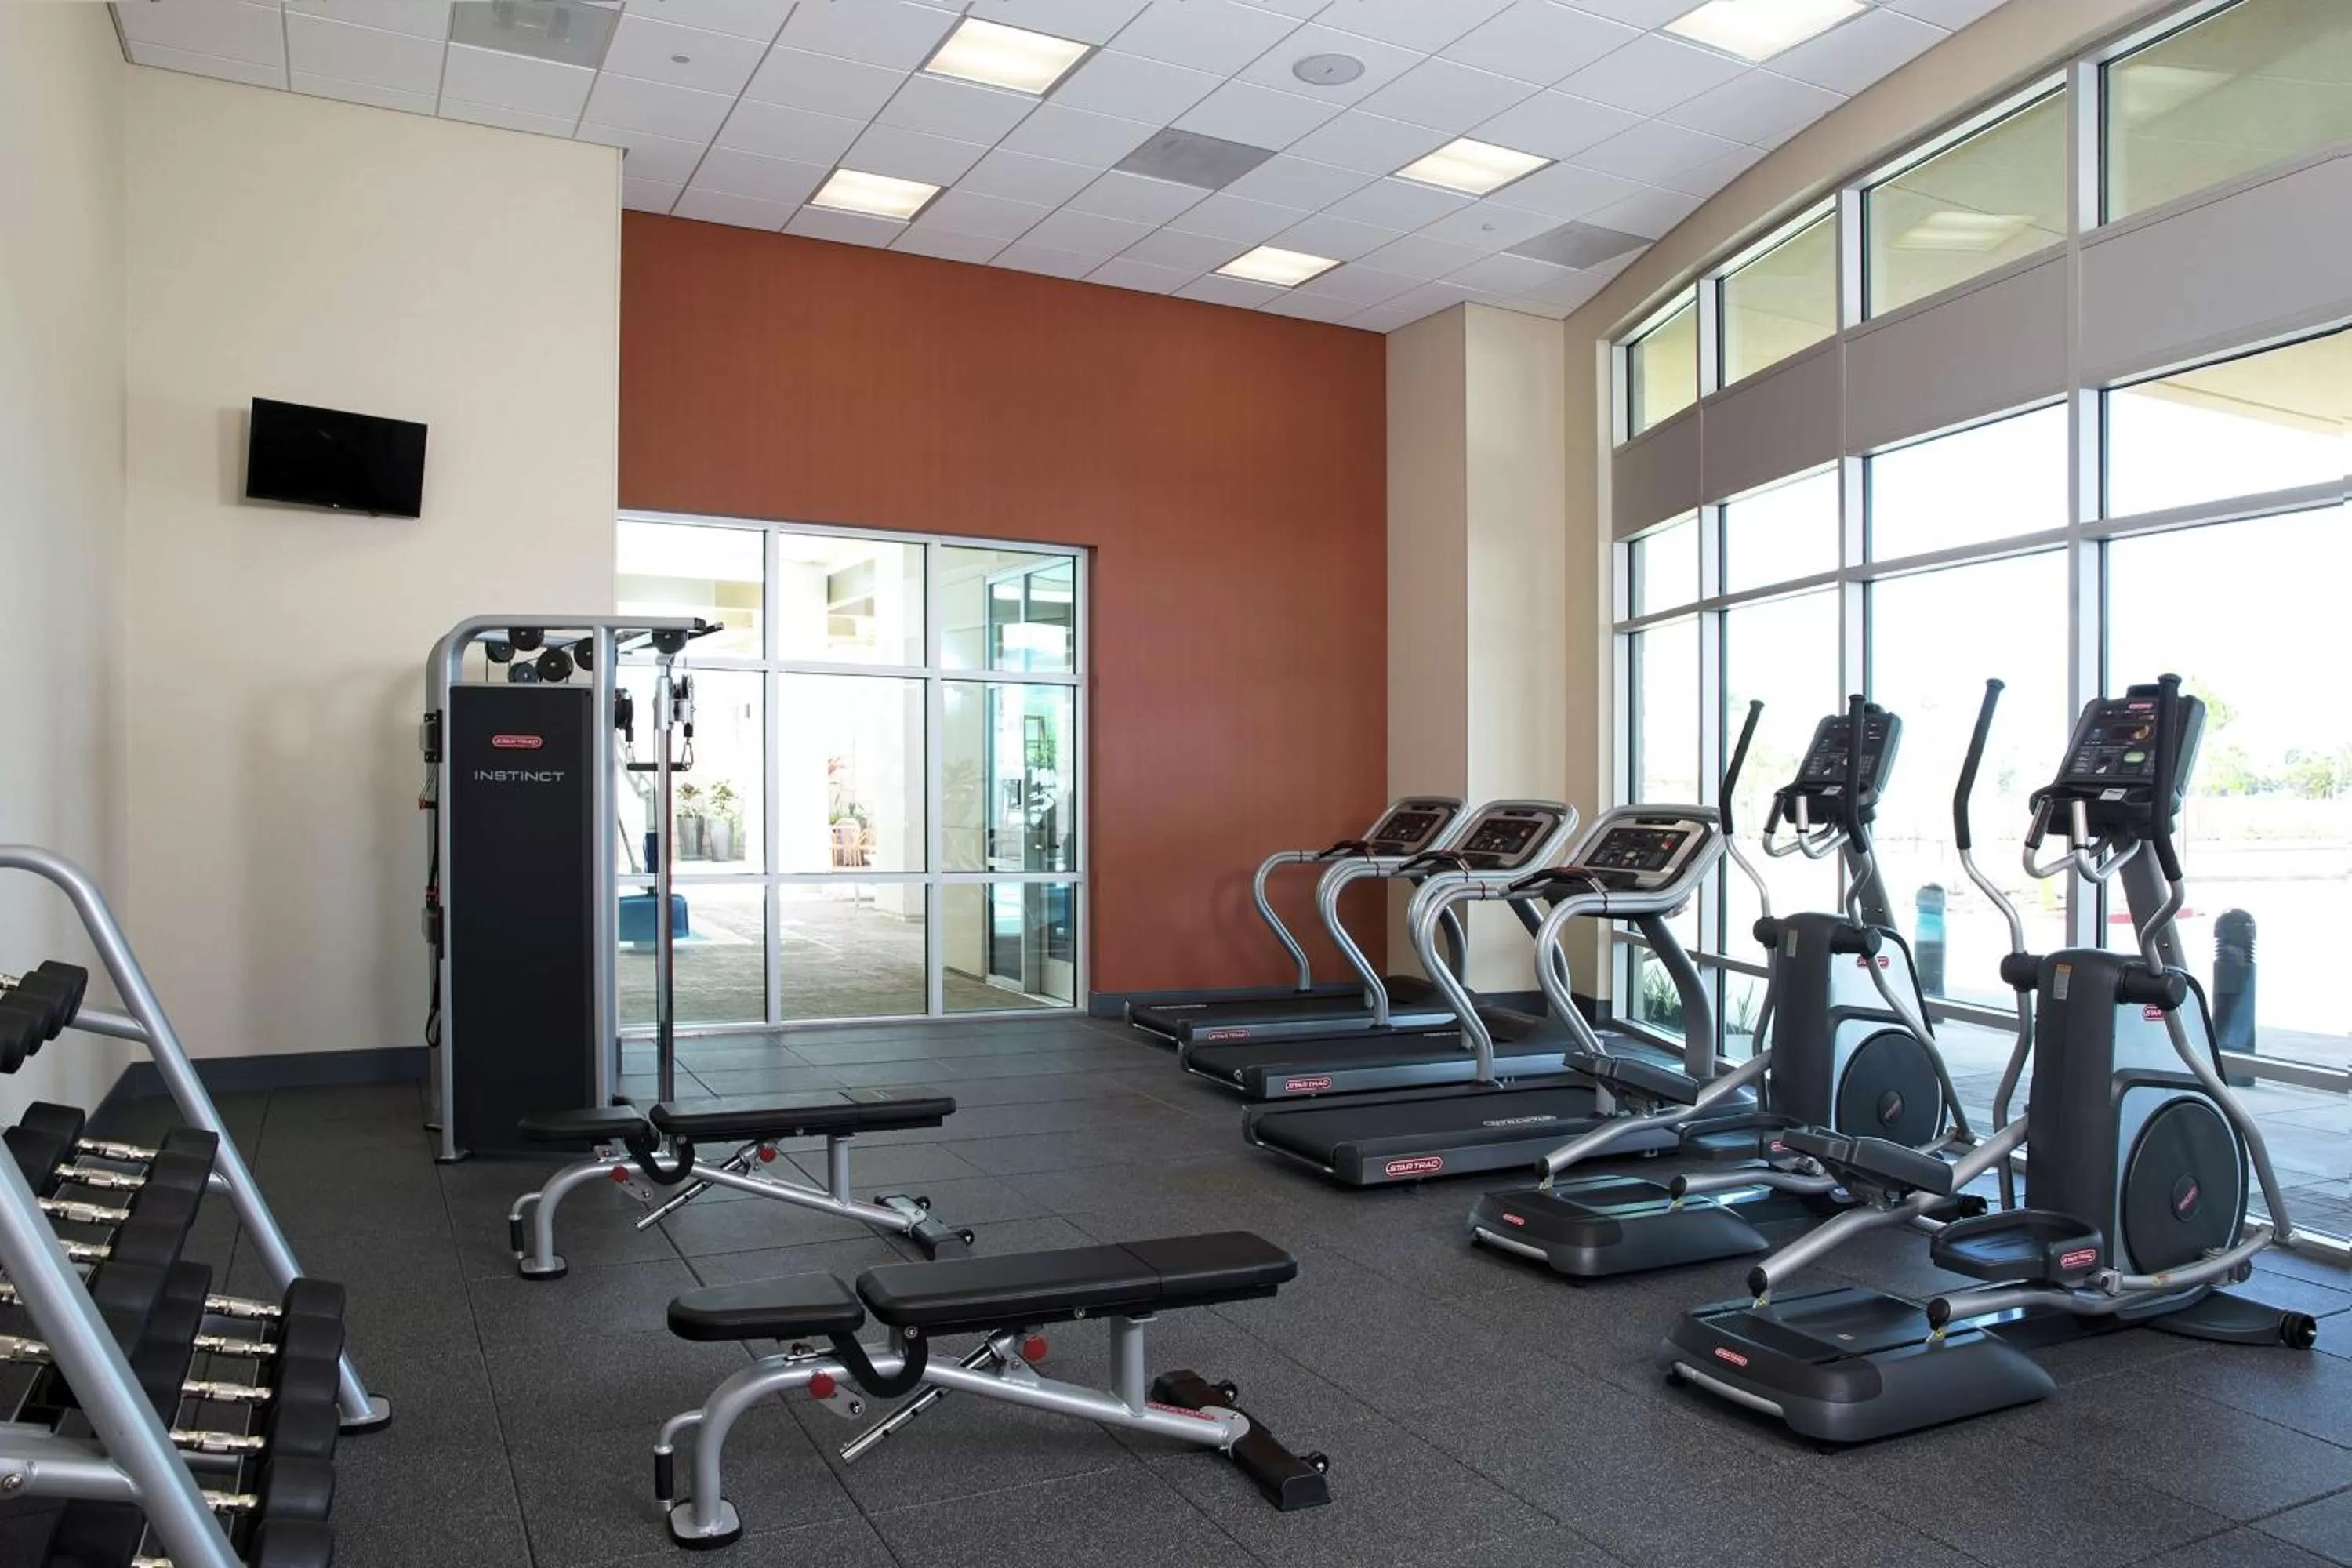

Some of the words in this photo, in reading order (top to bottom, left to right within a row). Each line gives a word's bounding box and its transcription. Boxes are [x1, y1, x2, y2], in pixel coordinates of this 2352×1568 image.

[474, 771, 565, 782] INSTINCT
[1390, 1163, 1414, 1172] STAR
[1414, 1160, 1440, 1169] TRAC
